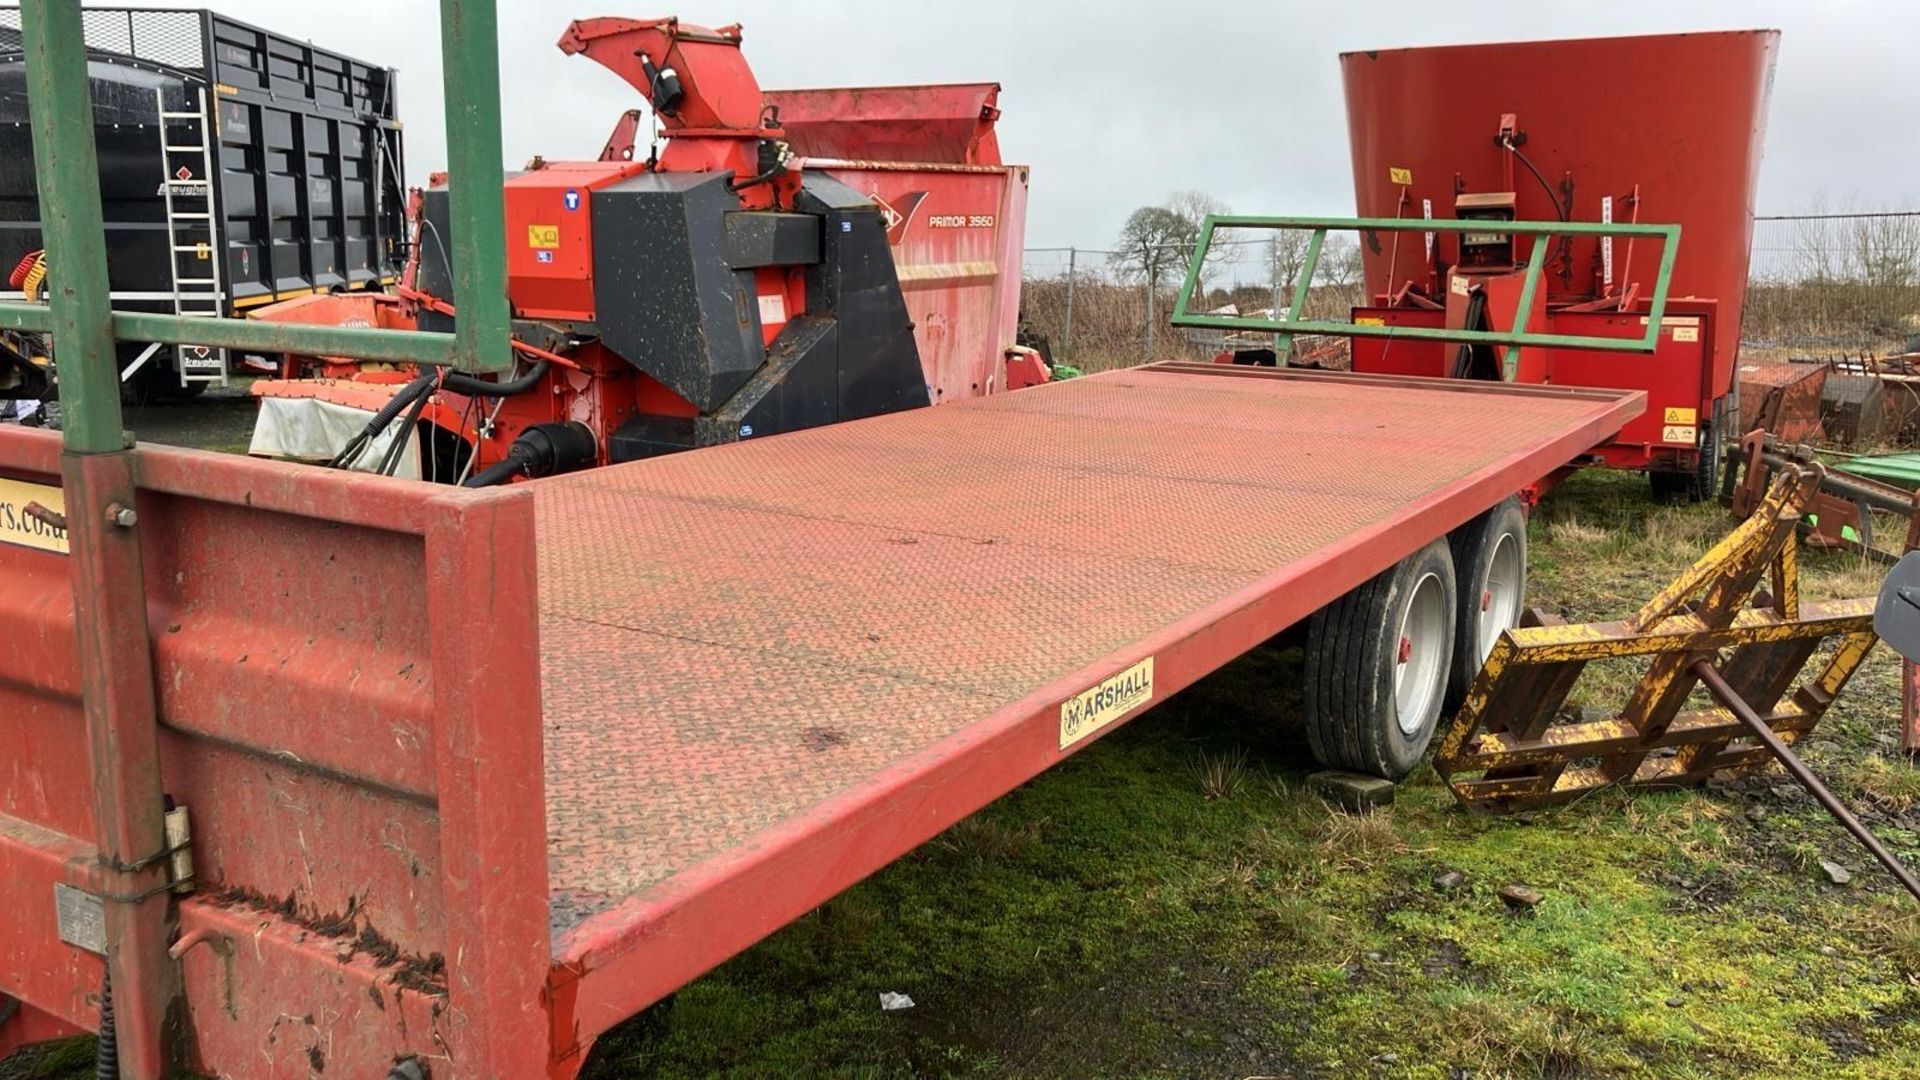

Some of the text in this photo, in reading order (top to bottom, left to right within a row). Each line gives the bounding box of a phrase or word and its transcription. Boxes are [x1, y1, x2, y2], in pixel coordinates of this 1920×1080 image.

[929, 215, 994, 228] PRIMOR 3560
[1067, 667, 1150, 729] MARSHALL
